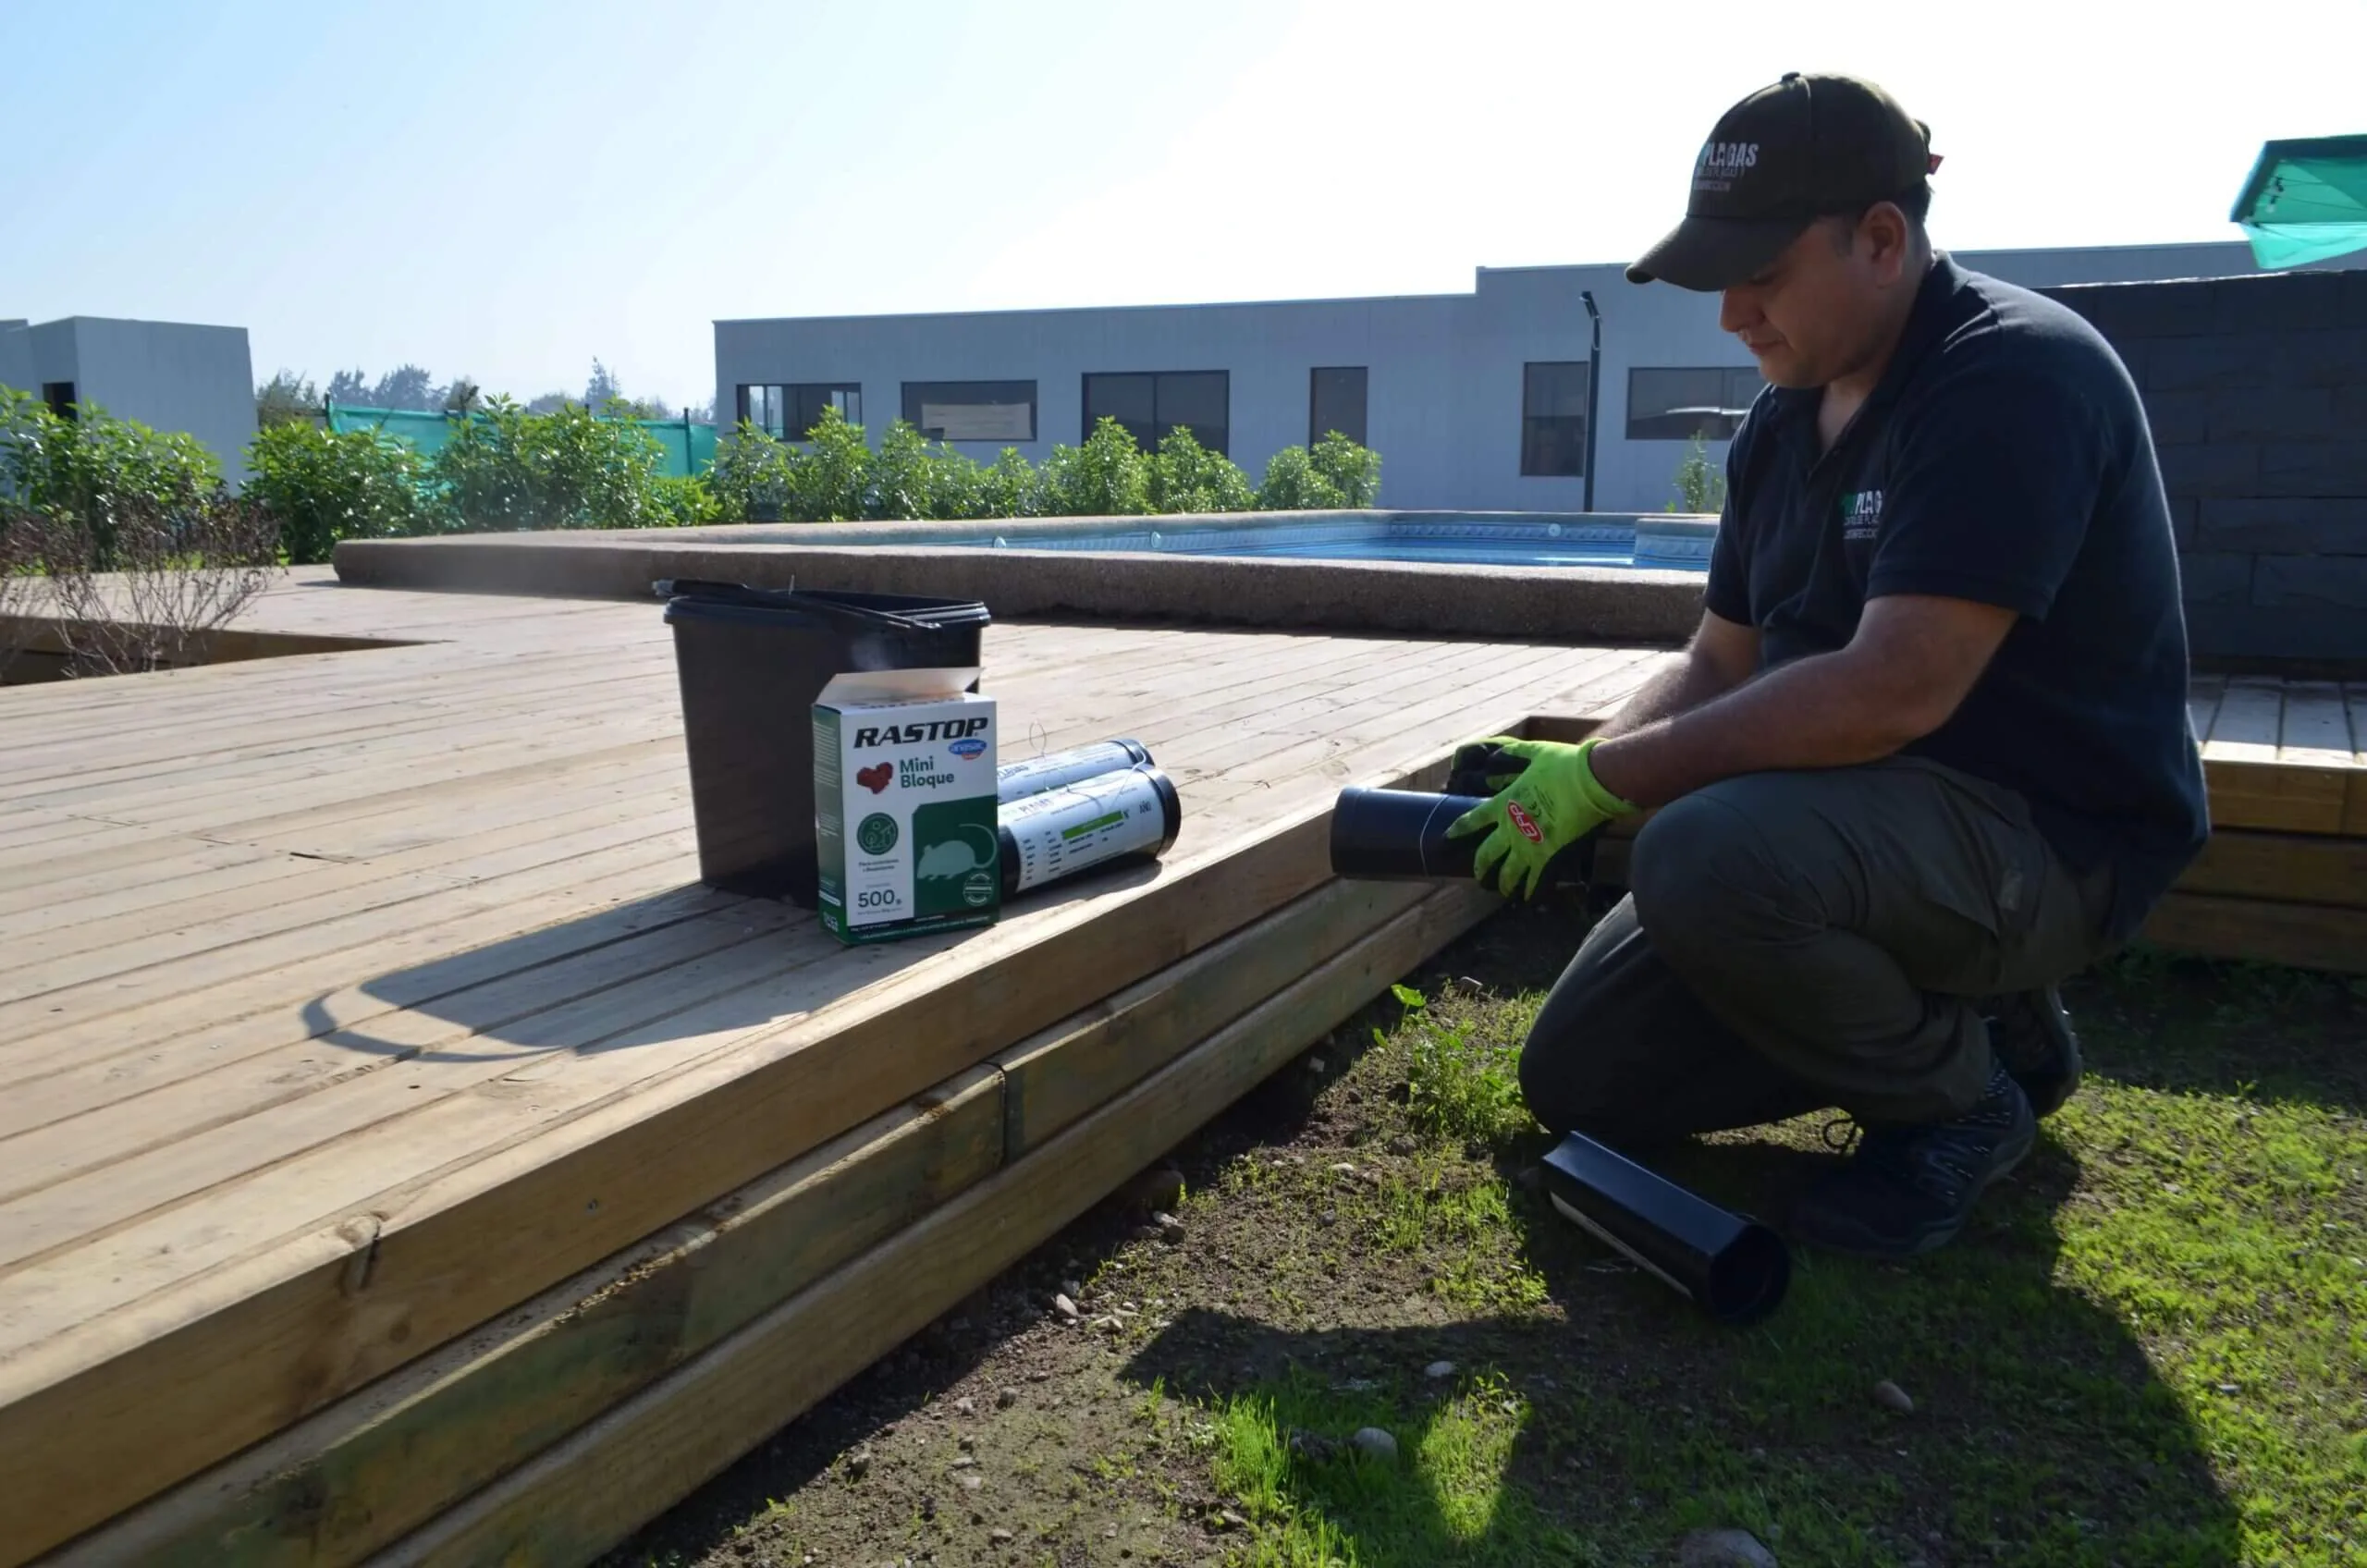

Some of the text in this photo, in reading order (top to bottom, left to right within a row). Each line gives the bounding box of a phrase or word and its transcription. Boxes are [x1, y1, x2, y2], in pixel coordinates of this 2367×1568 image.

[853, 717, 988, 749] RASTOP
[900, 755, 935, 773] Mini
[901, 773, 955, 789] Bloque
